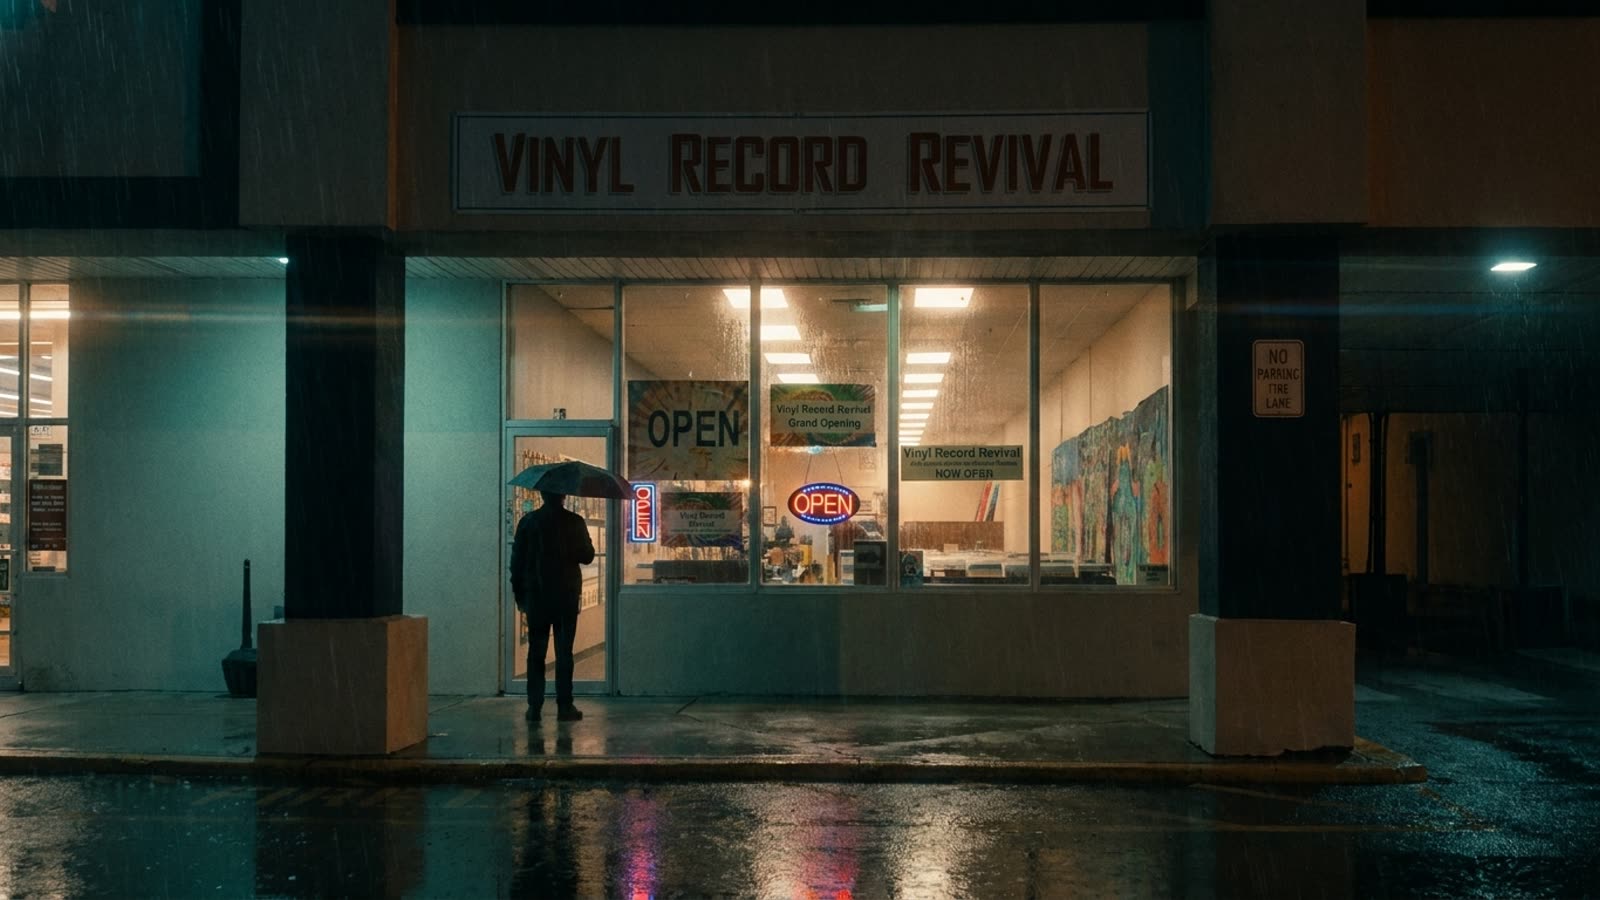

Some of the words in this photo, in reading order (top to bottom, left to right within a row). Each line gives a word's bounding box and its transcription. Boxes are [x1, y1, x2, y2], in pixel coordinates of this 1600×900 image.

[490, 132, 634, 195] VINYL
[668, 132, 868, 194] RECORD
[905, 131, 1113, 194] REVIVAL
[1269, 348, 1288, 365] NO
[1265, 397, 1291, 409] LANE
[648, 410, 740, 448] OPEN
[788, 418, 818, 428] Grand
[820, 418, 862, 429] Opening
[903, 447, 932, 460] Vinyl
[935, 447, 976, 458] Record
[978, 447, 1021, 458] Revival
[935, 469, 961, 478] NOW
[636, 487, 651, 538] OPEN
[794, 493, 853, 515] OPEN
